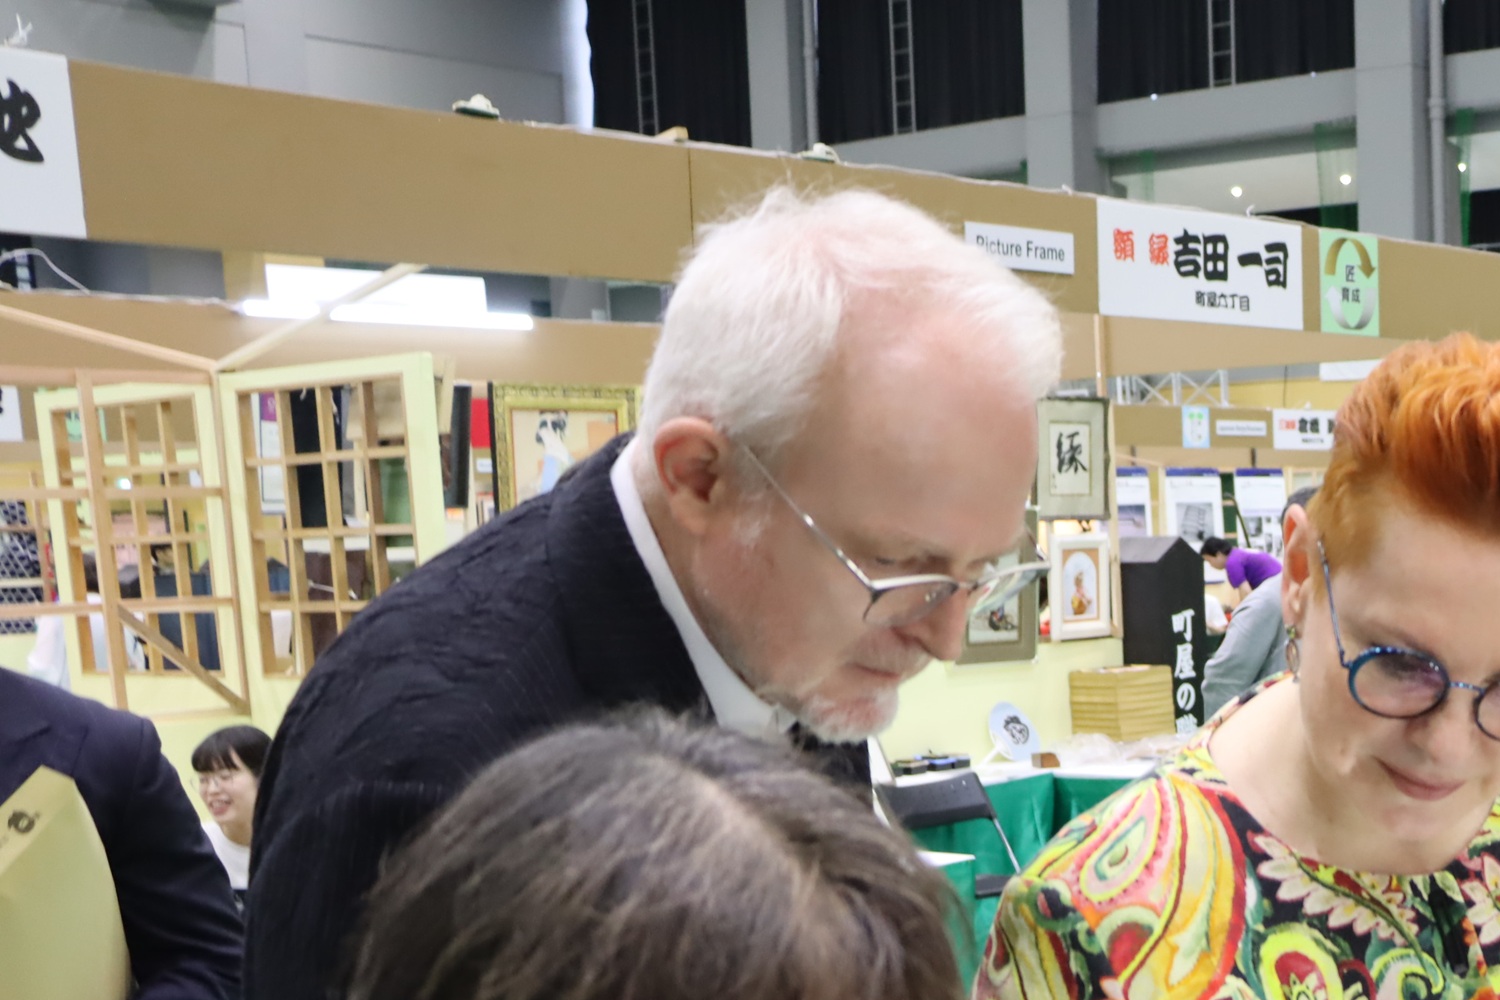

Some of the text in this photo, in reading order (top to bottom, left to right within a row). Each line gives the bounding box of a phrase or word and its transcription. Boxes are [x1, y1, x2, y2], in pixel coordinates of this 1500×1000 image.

[975, 233, 1066, 262] Picture Frame
[1172, 227, 1289, 290] 吉田一司
[1345, 264, 1355, 283] 匠
[1195, 291, 1250, 311] 町屋六丁目
[1341, 287, 1360, 303] 育成
